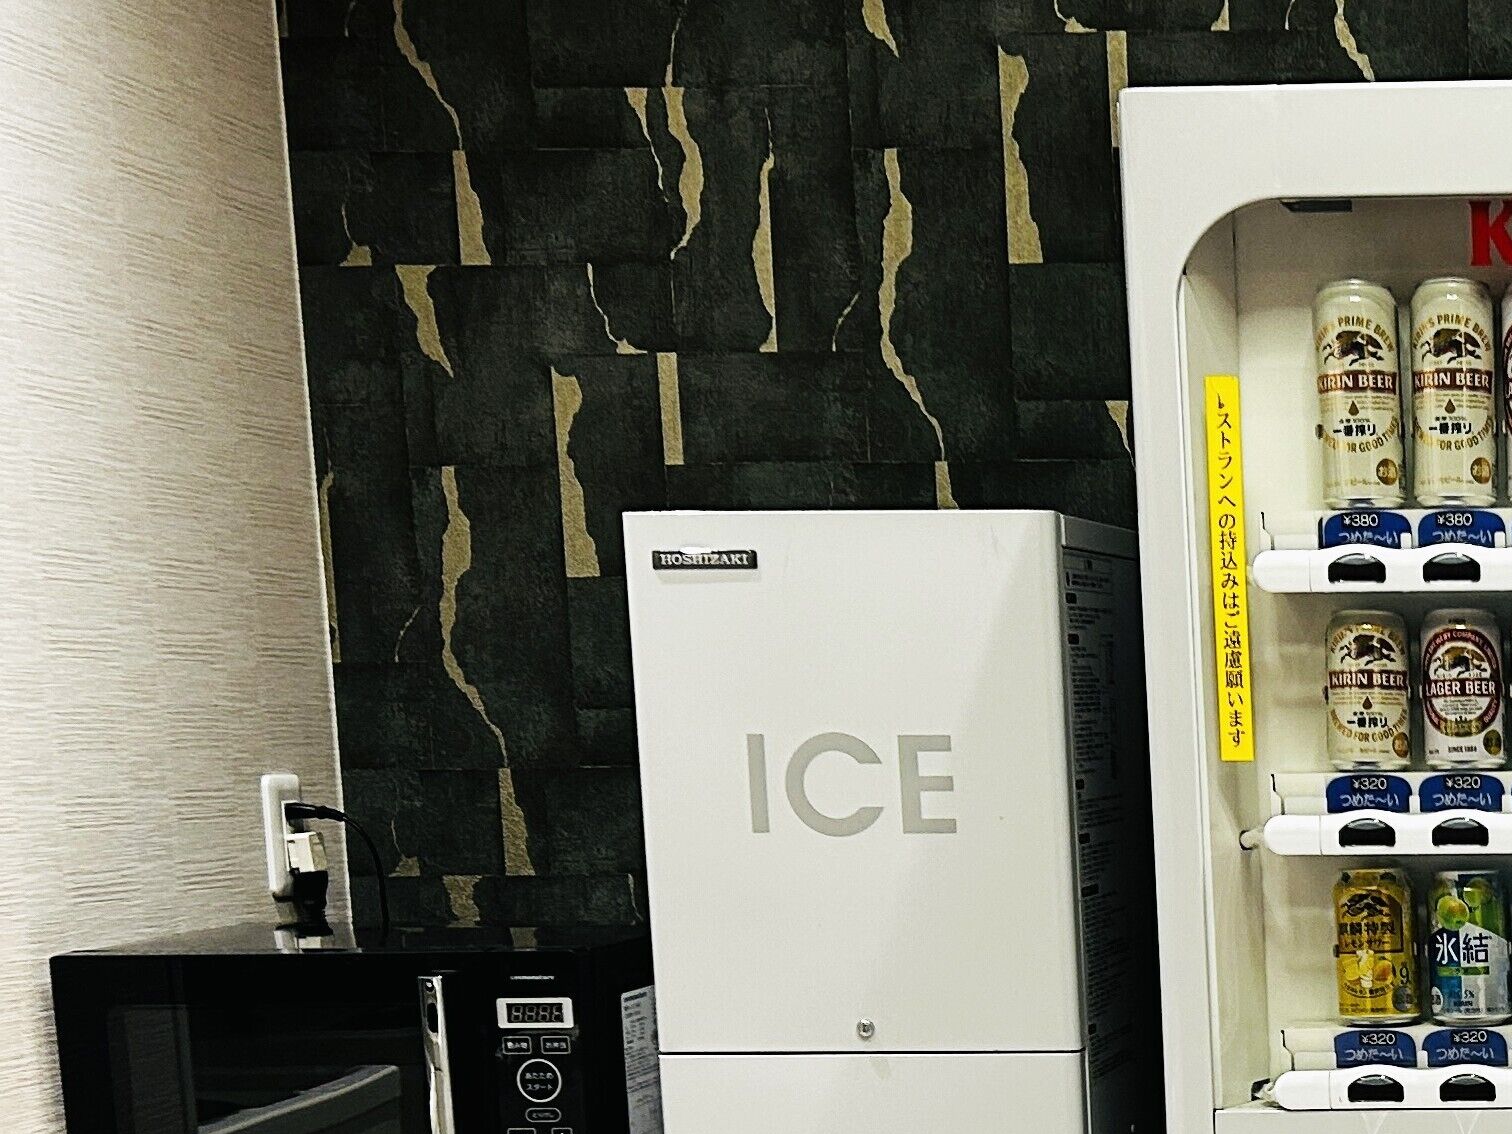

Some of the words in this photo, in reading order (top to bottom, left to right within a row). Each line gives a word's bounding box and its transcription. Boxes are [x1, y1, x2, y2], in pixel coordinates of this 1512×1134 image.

[1437, 313, 1470, 328] PRIME
[1318, 375, 1353, 393] KIRIN
[1358, 373, 1394, 391] BEER
[1415, 373, 1450, 389] KIRIN
[1455, 371, 1490, 389] BEER
[1333, 423, 1377, 437] 一番搾り
[1428, 421, 1472, 436] 一番搾り
[1342, 513, 1379, 527] ¥380
[1437, 511, 1473, 526] ¥380
[660, 553, 749, 565] HOSHIZAKI
[1216, 392, 1245, 748] レストランへの持込みはご遠慮願います
[1331, 672, 1368, 687] KIRIN
[1372, 672, 1405, 687] BEER
[1426, 680, 1461, 697] LAGER
[1465, 680, 1496, 695] BEER
[1352, 731, 1371, 743] FOR
[1371, 726, 1394, 742] GOOD
[746, 731, 957, 837] ICE
[1352, 777, 1387, 790] ¥320
[1445, 776, 1481, 789] ¥320
[1435, 932, 1491, 965] 氷結
[1361, 1033, 1396, 1045] ¥320
[1453, 1031, 1488, 1043] ¥320
